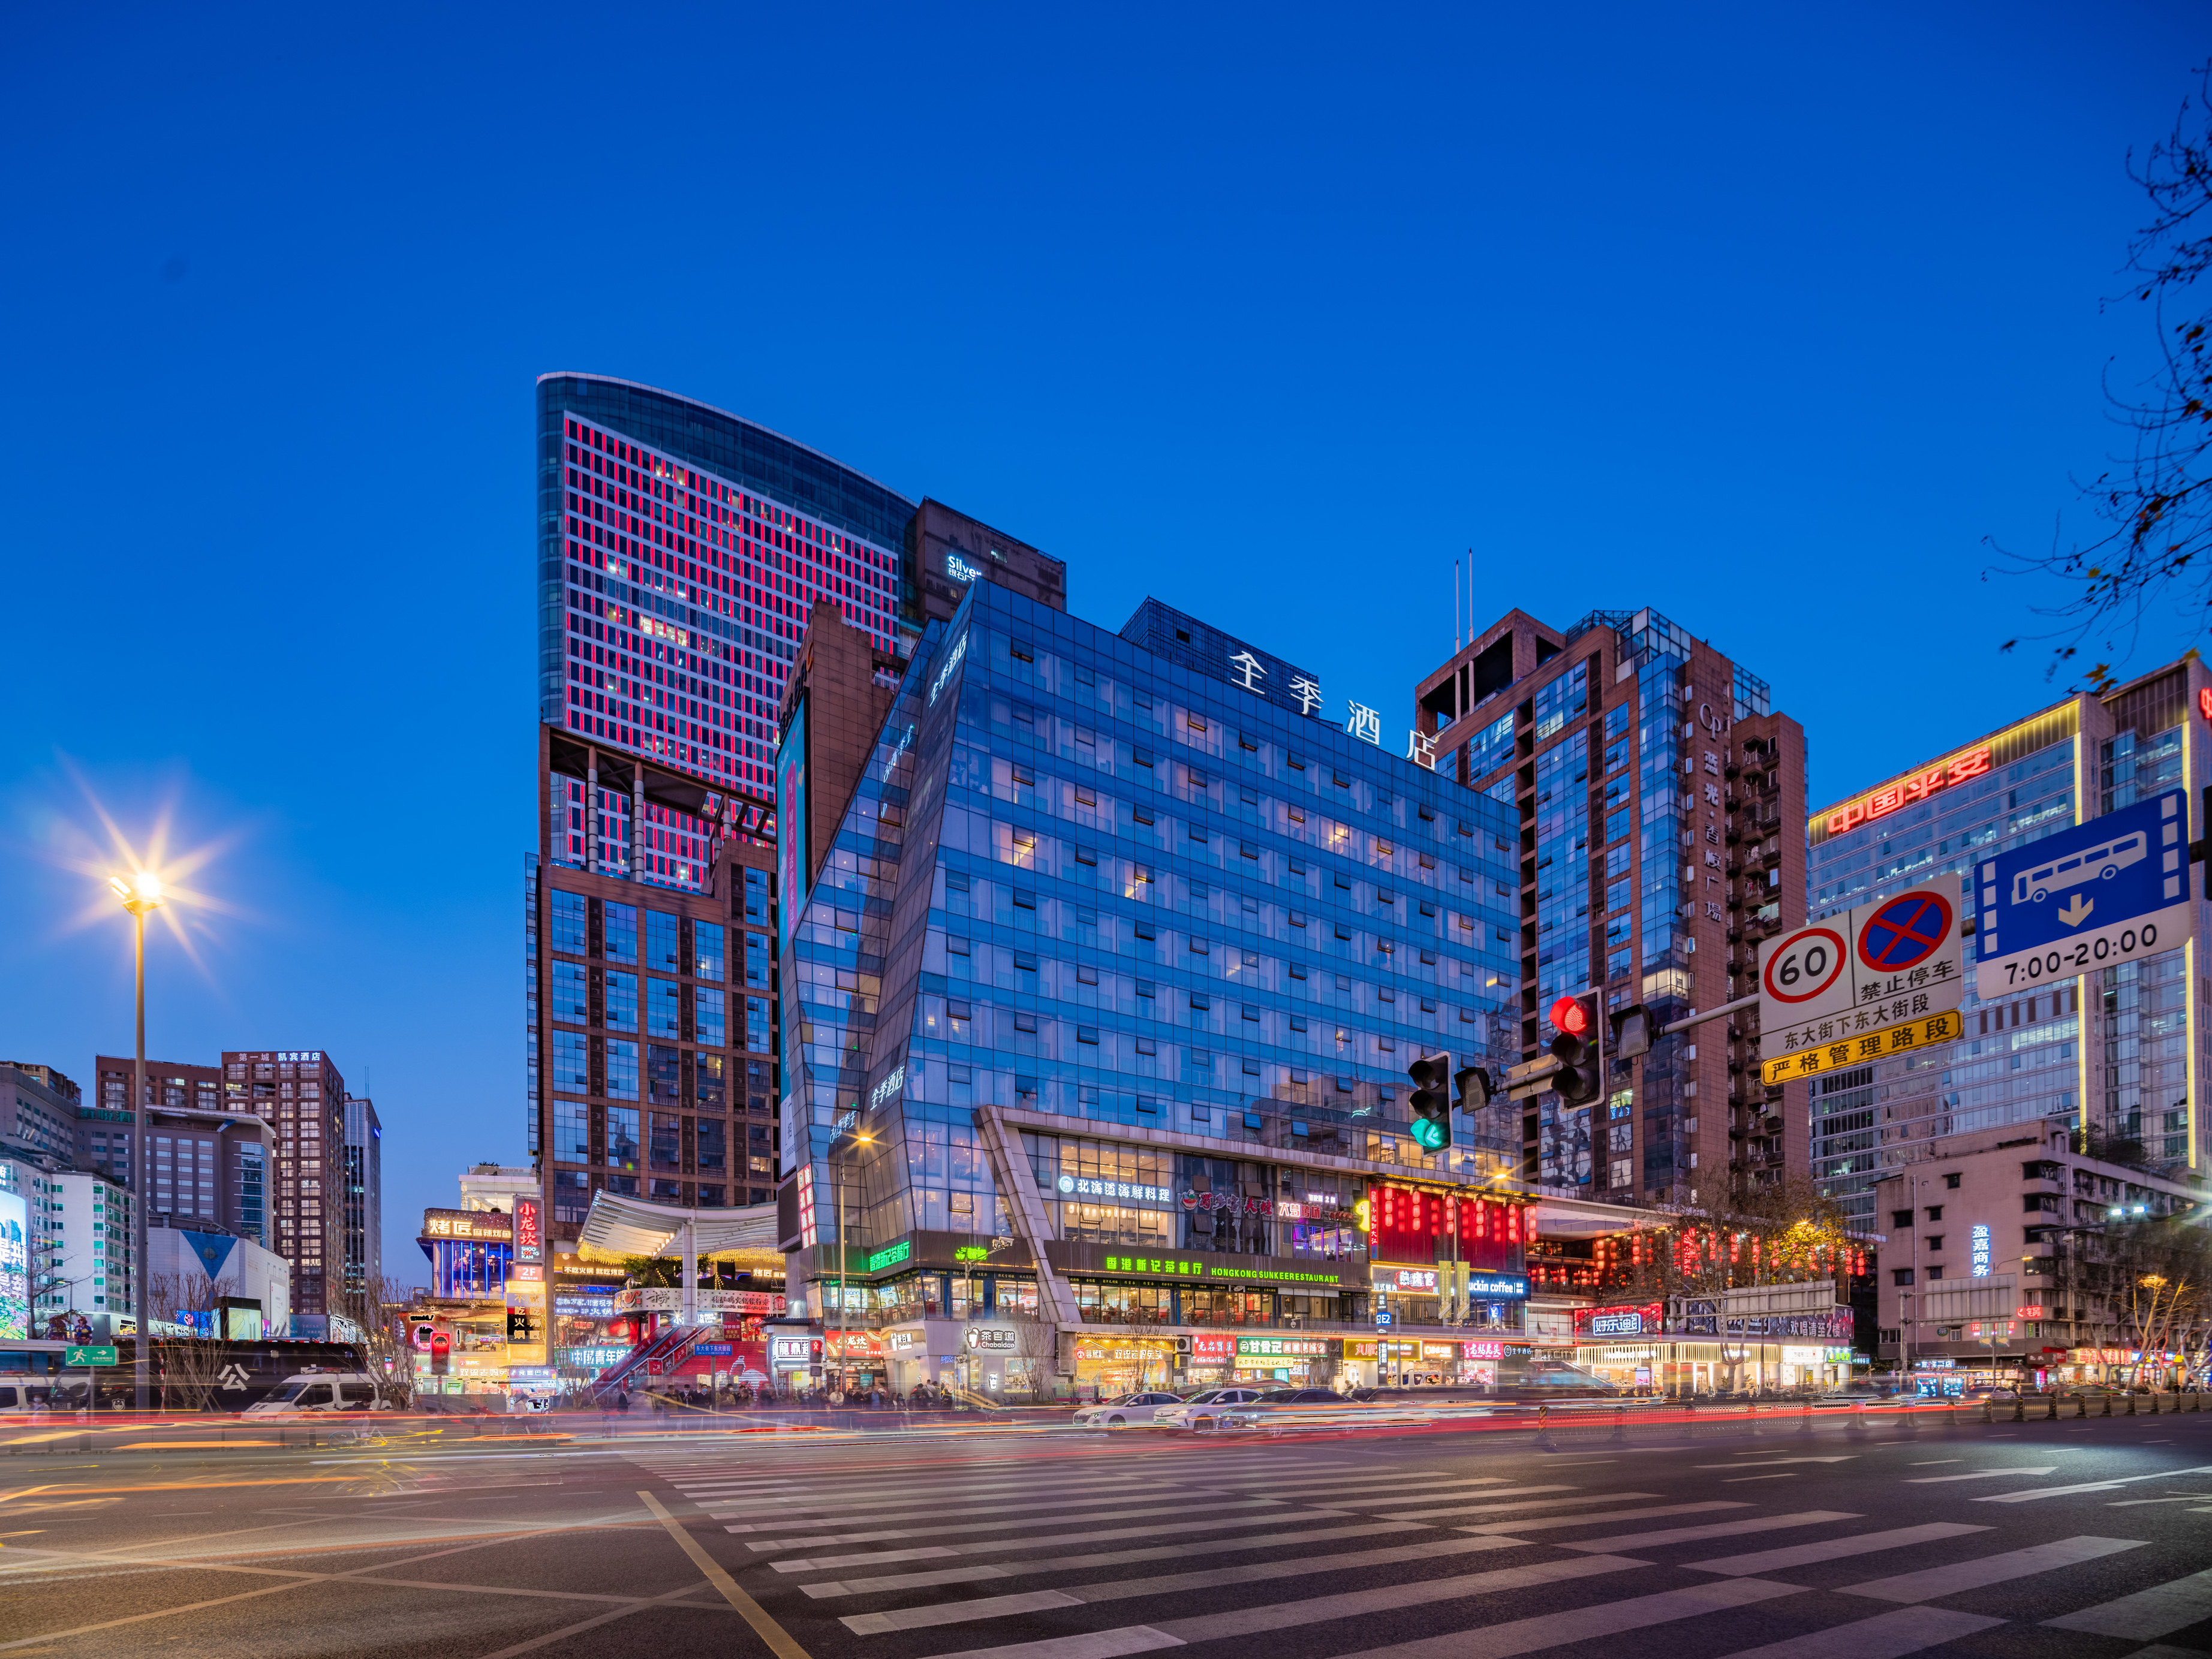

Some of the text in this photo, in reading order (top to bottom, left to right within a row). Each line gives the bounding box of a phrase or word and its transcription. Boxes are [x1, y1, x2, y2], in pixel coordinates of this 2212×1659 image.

[949, 567, 974, 582] 银石广
[929, 630, 968, 707] 全季酒店
[1229, 651, 1436, 771] 全季酒店
[1827, 745, 1990, 834] 中国平安
[2005, 924, 2157, 985] 7:00-20:00
[1779, 946, 1827, 986] 60
[1861, 961, 1955, 1002] 禁止停车
[1784, 993, 1930, 1050] 东大街下东大街段
[239, 1053, 270, 1061] 第一城
[278, 1052, 321, 1061] 凯宾酒店
[1771, 1017, 1951, 1081] 严格管理路段
[870, 1065, 905, 1111] 全季酒店
[1078, 1179, 1170, 1202] 北海道海鲜料理
[1279, 1202, 1321, 1219] 大梦烤场
[429, 1219, 511, 1238] 烤匠 麻辣烤鱼
[519, 1202, 539, 1246] 小龙坎
[869, 1241, 910, 1272] 香港新记茶餐厅
[1973, 1226, 1989, 1277] 盈嘉商务
[522, 1267, 536, 1276] 2F
[595, 1267, 625, 1276] 就吃烤匠
[753, 1269, 774, 1278] 烤匠
[1106, 1257, 1203, 1275] 香港新记茶餐厅
[1211, 1267, 1257, 1278] HONGKONG
[1468, 1280, 1513, 1293] uckin coffee
[1382, 1314, 1391, 1324] E2
[1595, 1317, 1638, 1333] 好乐迪
[982, 1331, 1015, 1341] 茶百道
[1790, 1320, 1840, 1338] 欢唱请至2楼
[571, 1350, 631, 1365] 中国青年旅
[1356, 1342, 1378, 1356] 丸摩
[218, 1363, 251, 1391] 公
